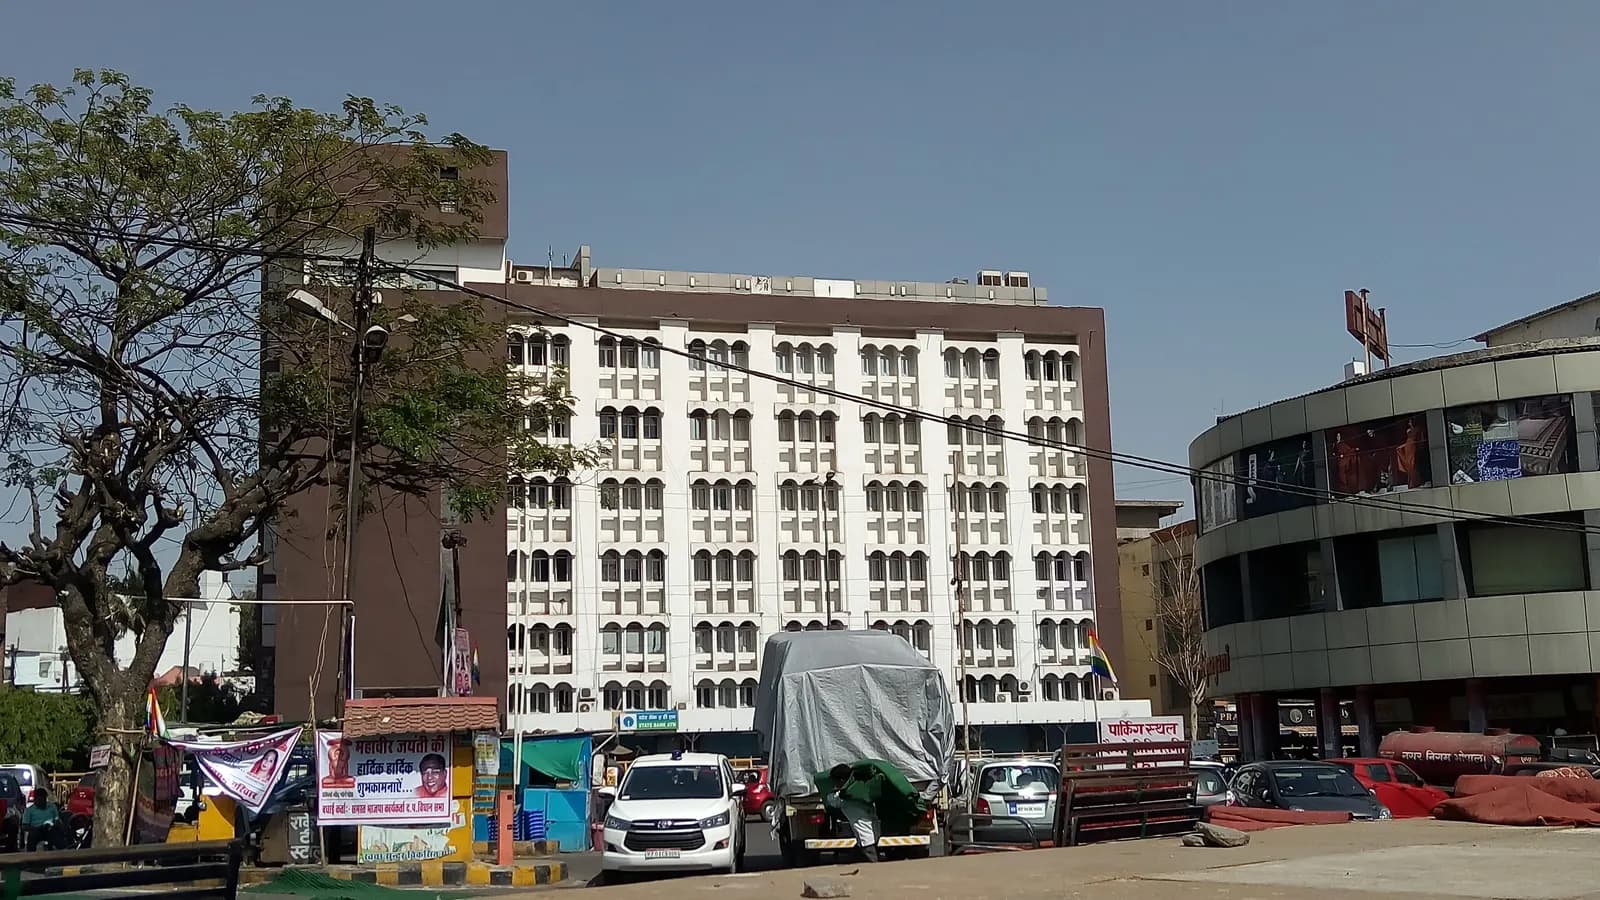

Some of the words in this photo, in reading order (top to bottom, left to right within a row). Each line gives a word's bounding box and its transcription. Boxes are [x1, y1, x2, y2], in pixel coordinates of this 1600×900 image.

[1145, 722, 1178, 736] स्थल
[355, 737, 393, 754] महावीर
[397, 736, 428, 754] जयंती
[431, 735, 444, 753] की
[1402, 751, 1422, 761] नगर
[1425, 750, 1451, 761] निगम
[357, 759, 384, 776] हार्दिक
[386, 758, 413, 775] हार्दिक
[367, 804, 384, 814] भाजपा
